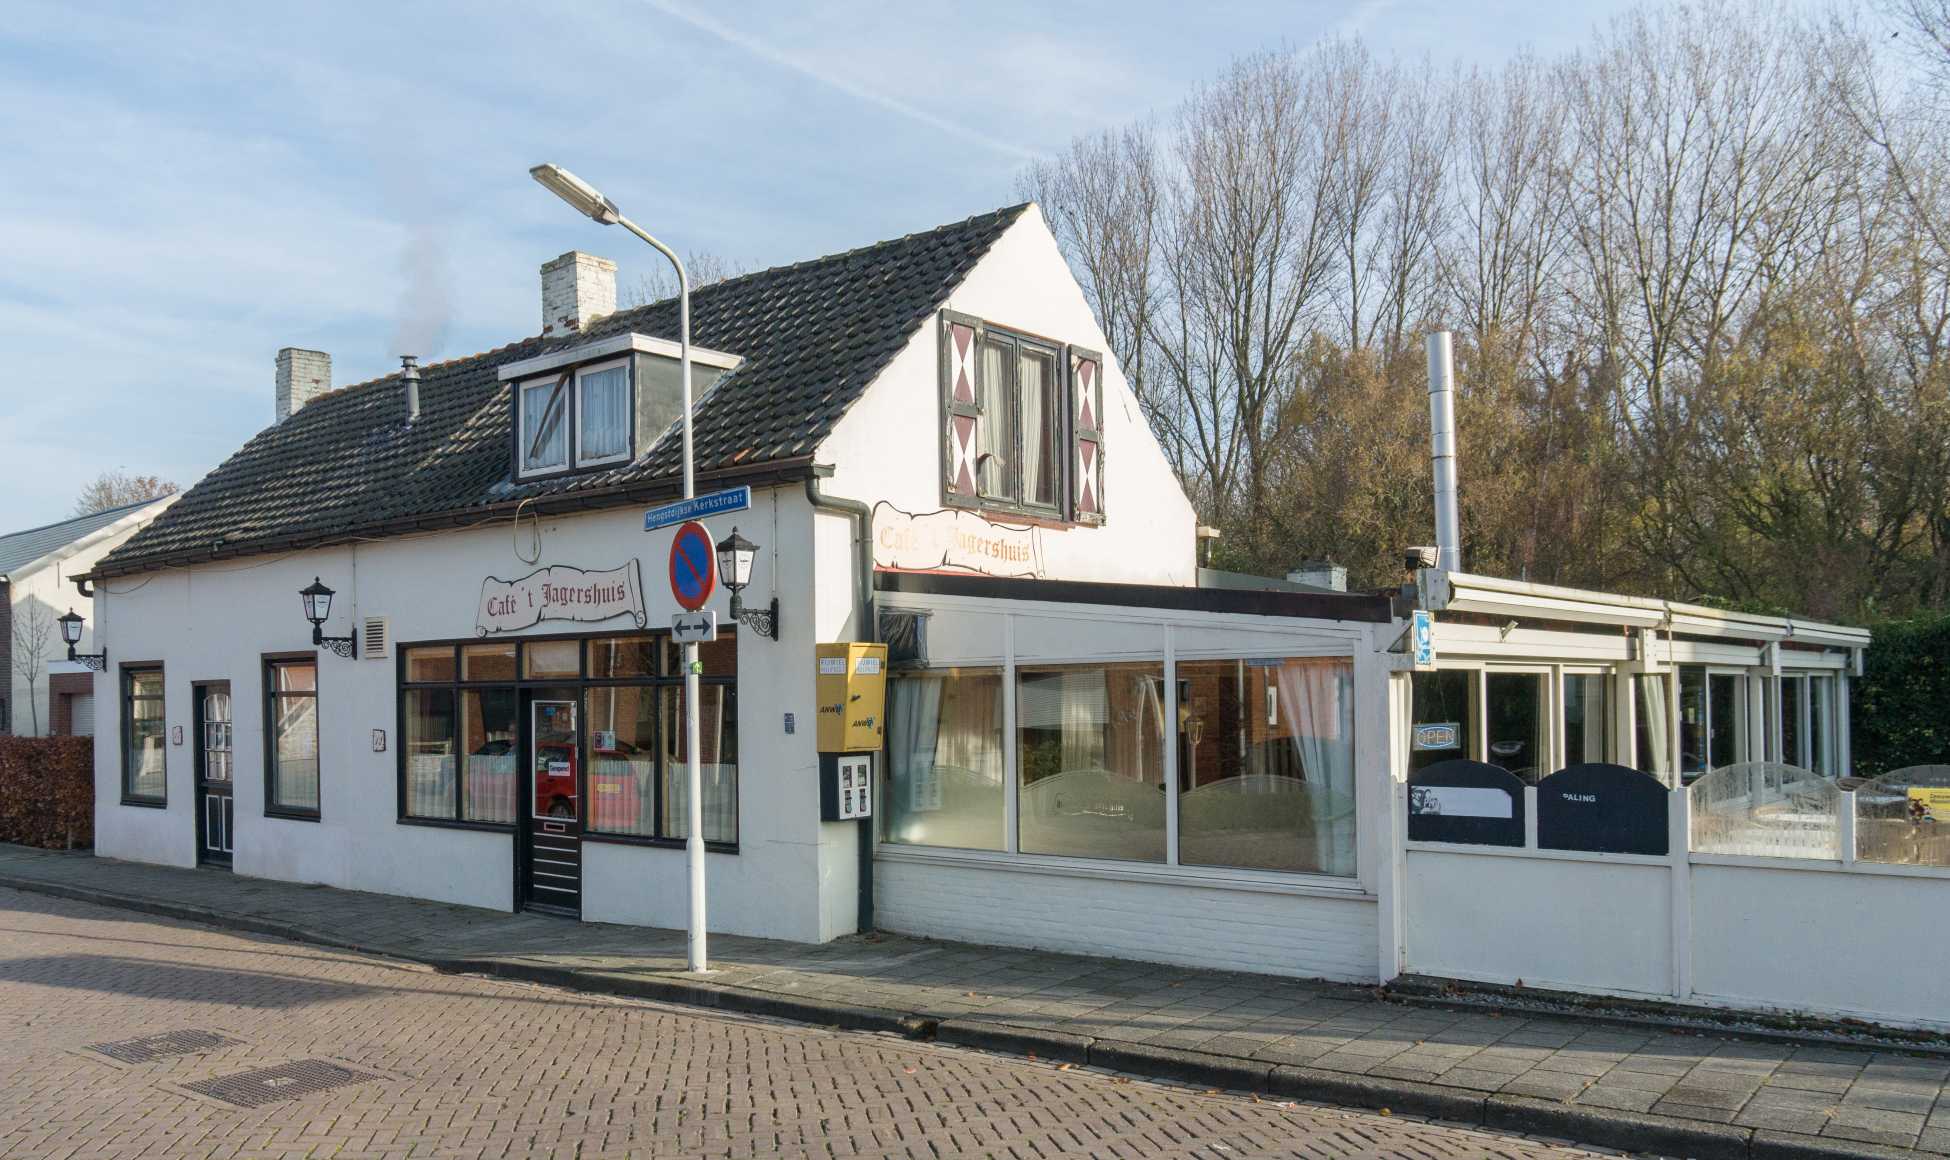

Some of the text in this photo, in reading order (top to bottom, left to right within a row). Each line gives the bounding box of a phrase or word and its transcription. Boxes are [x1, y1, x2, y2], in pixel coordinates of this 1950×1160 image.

[693, 493, 743, 511] Kerkstraat
[487, 594, 517, 617] Café
[541, 580, 625, 608] Jagershuis
[1417, 730, 1456, 745] OPEN
